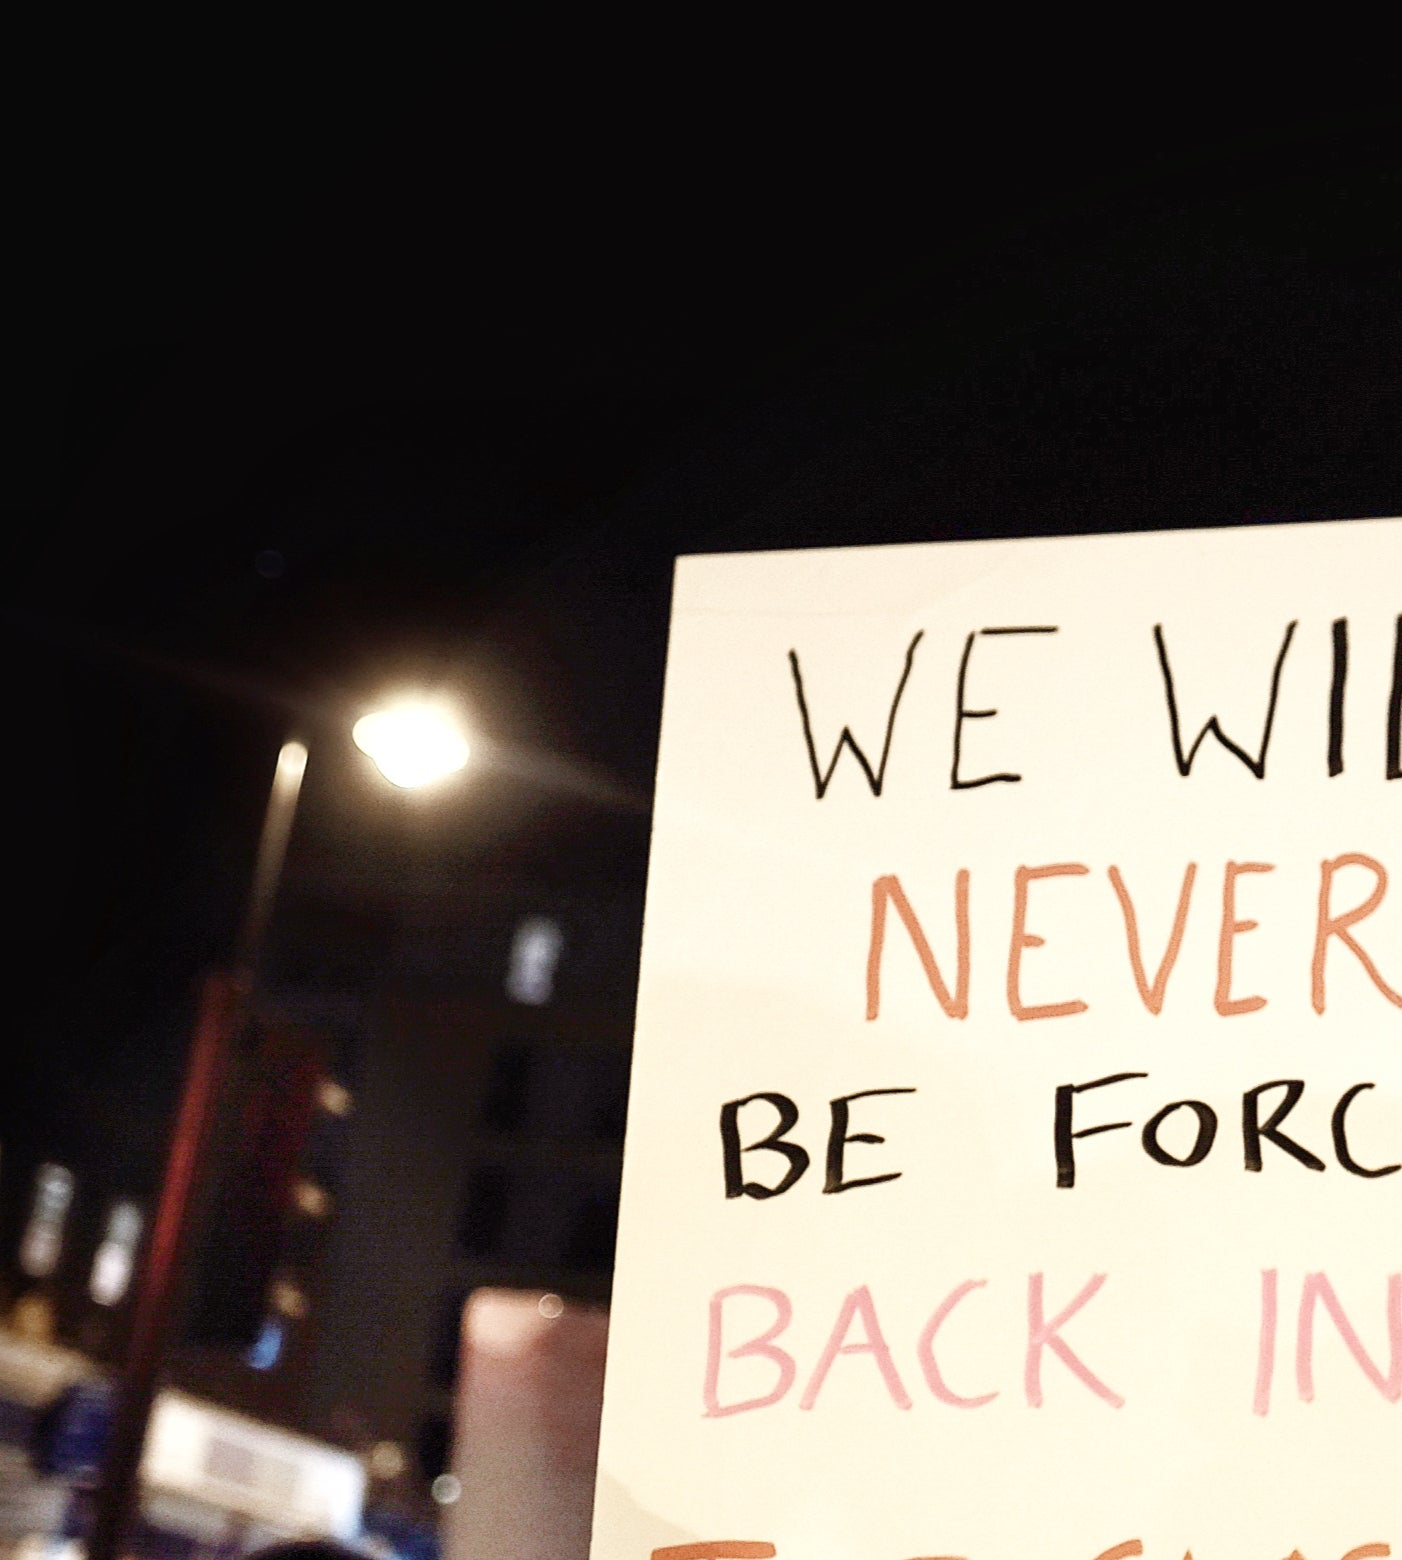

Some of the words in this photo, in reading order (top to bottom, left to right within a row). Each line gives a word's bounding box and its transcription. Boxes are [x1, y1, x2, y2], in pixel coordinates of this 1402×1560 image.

[789, 627, 1056, 799] WE
[721, 1090, 916, 1199] BE
[704, 1273, 1122, 1418] BACK
